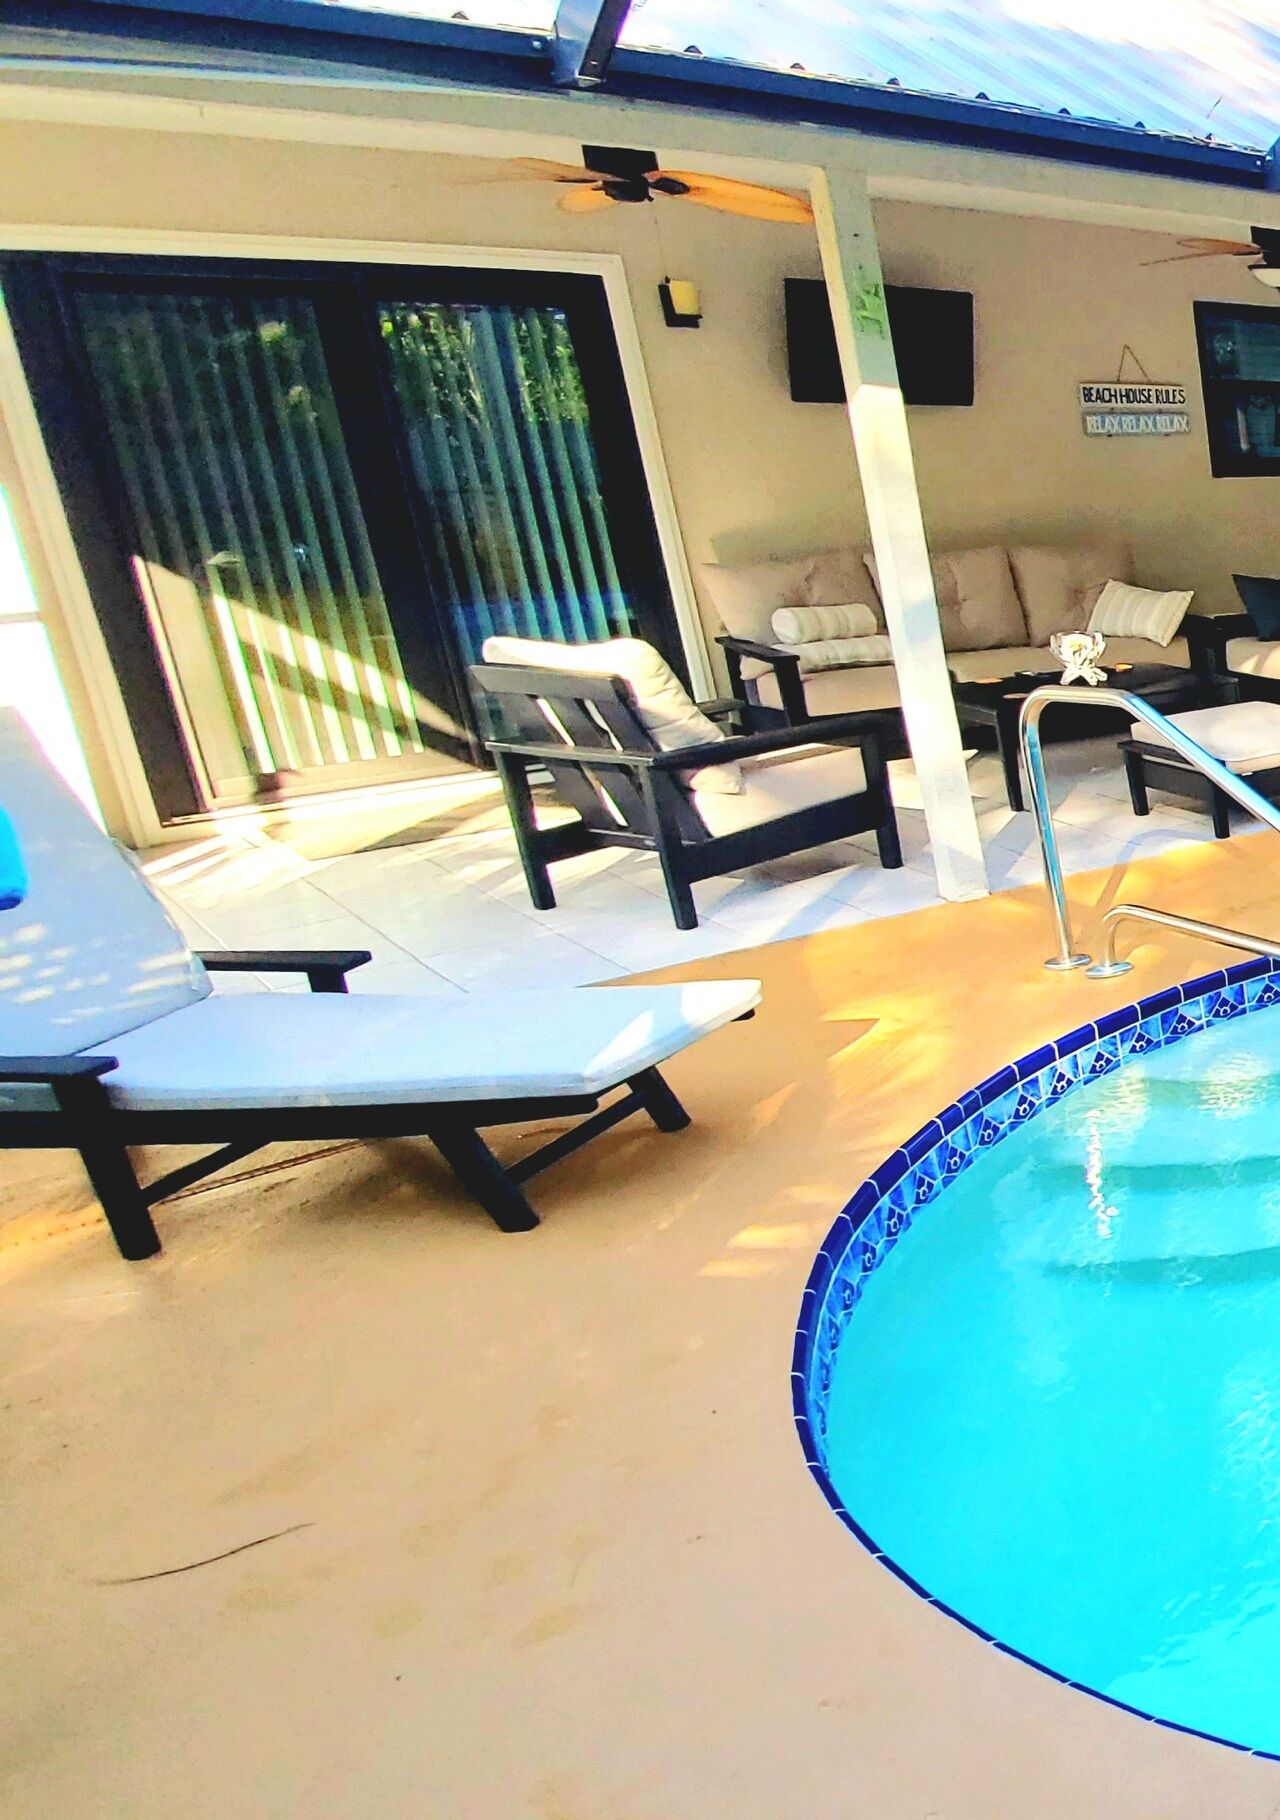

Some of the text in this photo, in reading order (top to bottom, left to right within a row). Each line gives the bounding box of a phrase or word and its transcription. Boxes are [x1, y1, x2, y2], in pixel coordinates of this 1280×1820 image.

[1082, 387, 1186, 405] BEACH HOUSE RULES
[1086, 415, 1189, 433] RELAX RELAX RELAX
